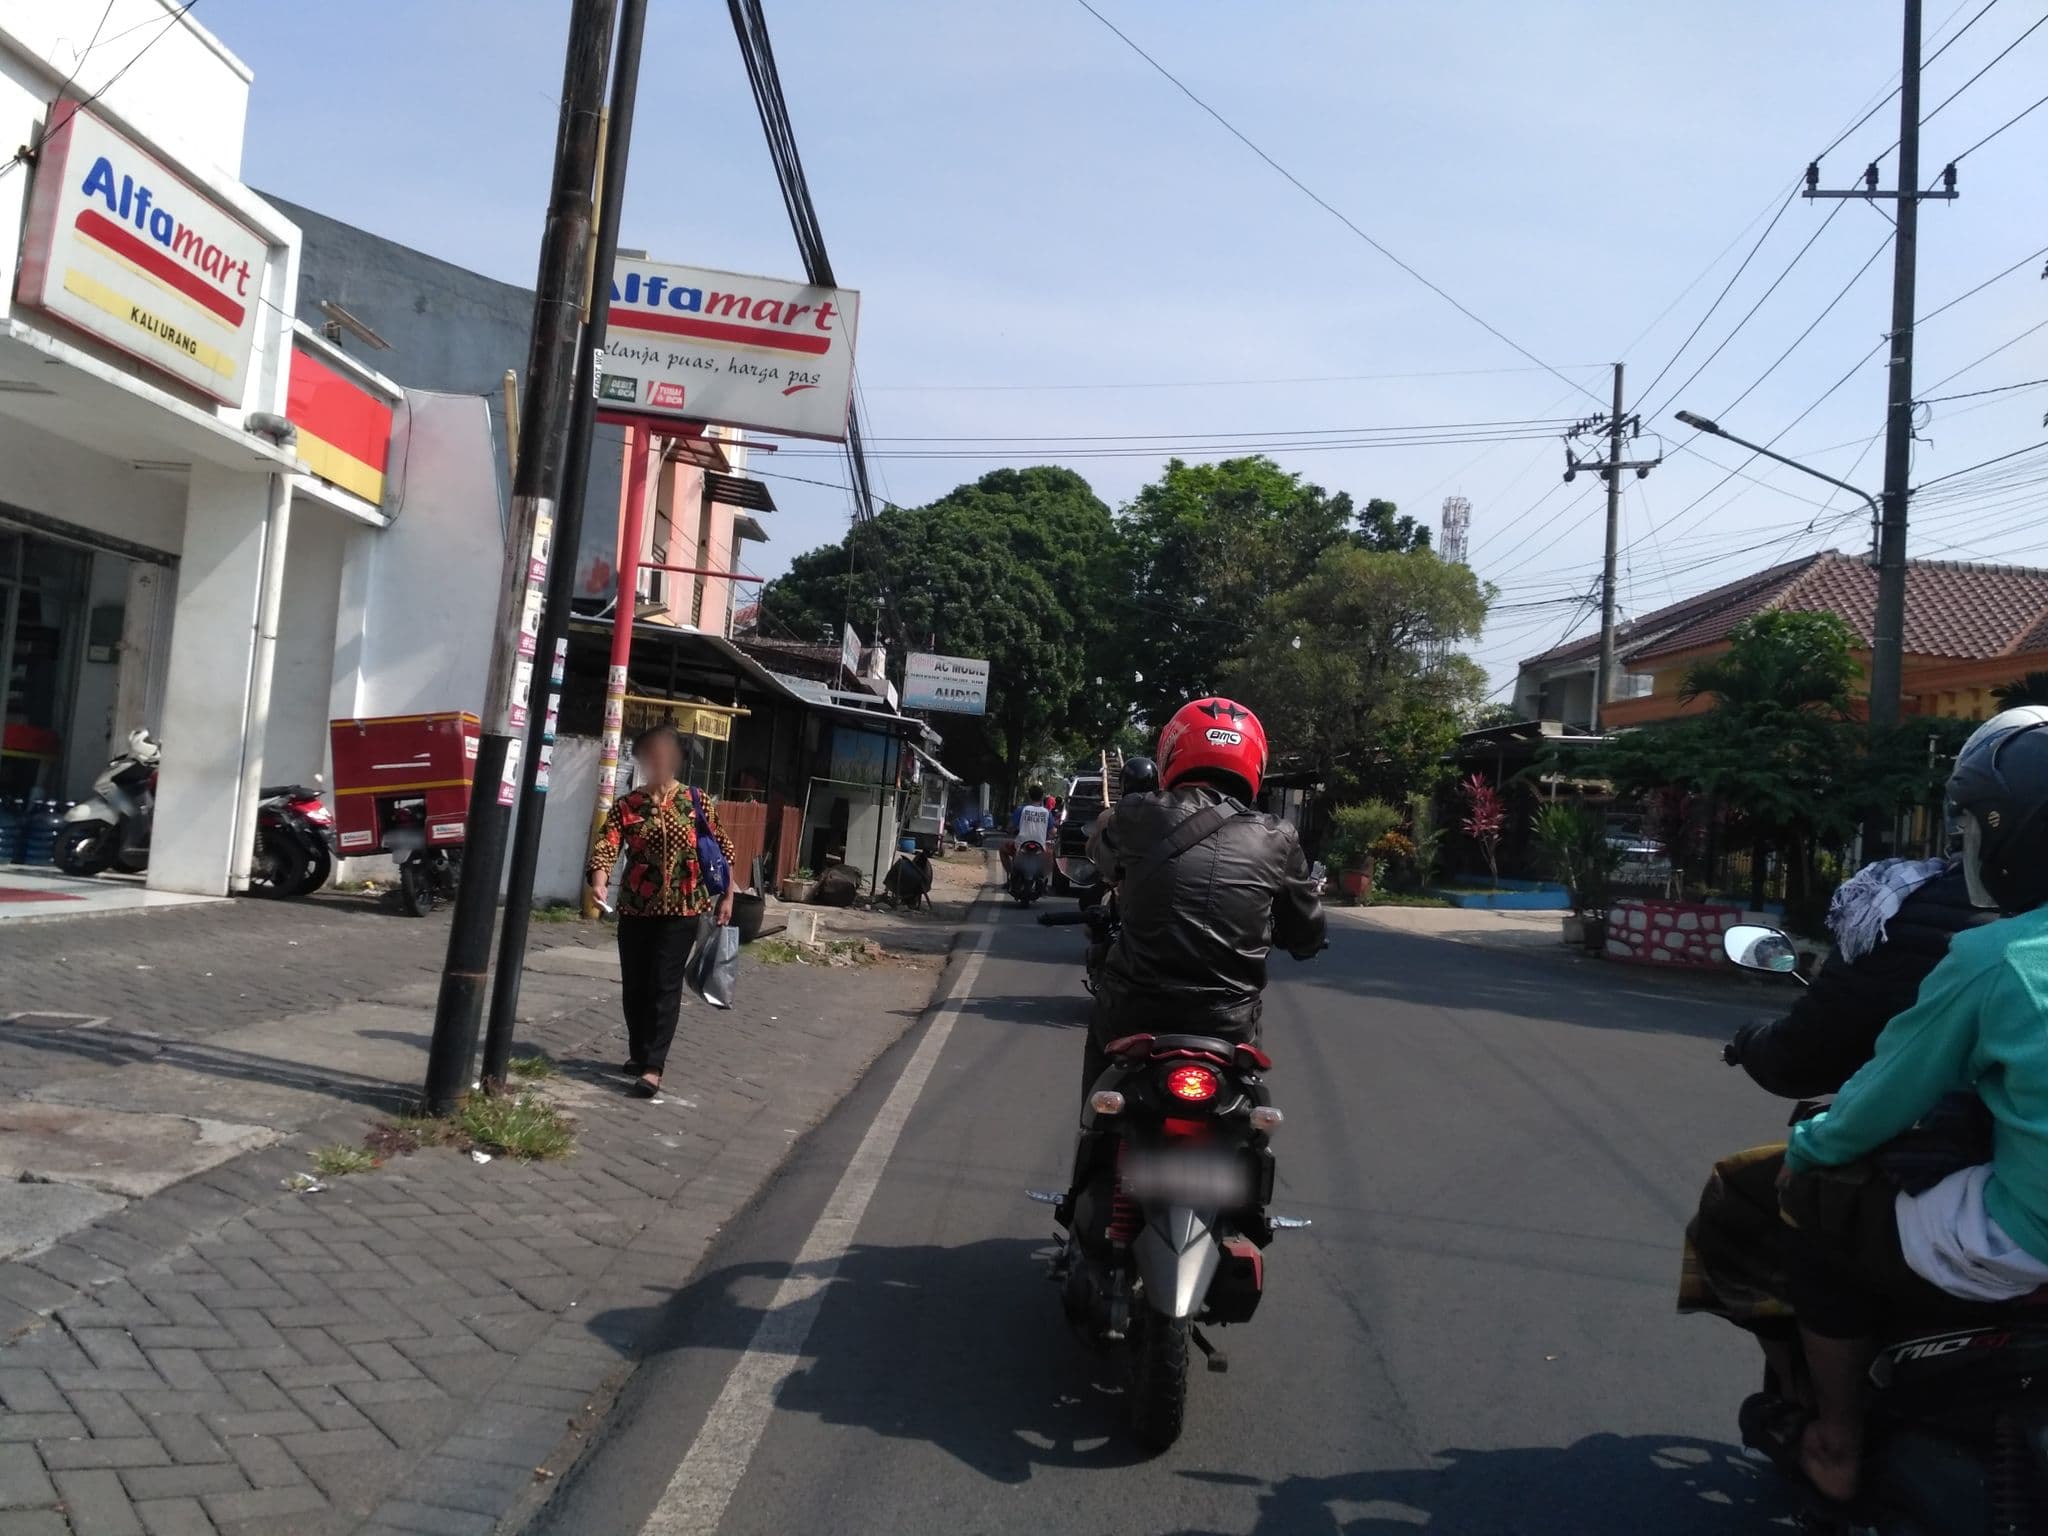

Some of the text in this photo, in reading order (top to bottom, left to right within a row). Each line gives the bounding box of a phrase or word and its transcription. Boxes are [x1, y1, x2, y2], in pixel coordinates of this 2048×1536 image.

[81, 156, 251, 297] Alfamart
[603, 340, 821, 386] elanja puas, harga pas
[934, 661, 949, 672] AC
[935, 687, 981, 704] AUDIO
[1210, 731, 1238, 743] BMC
